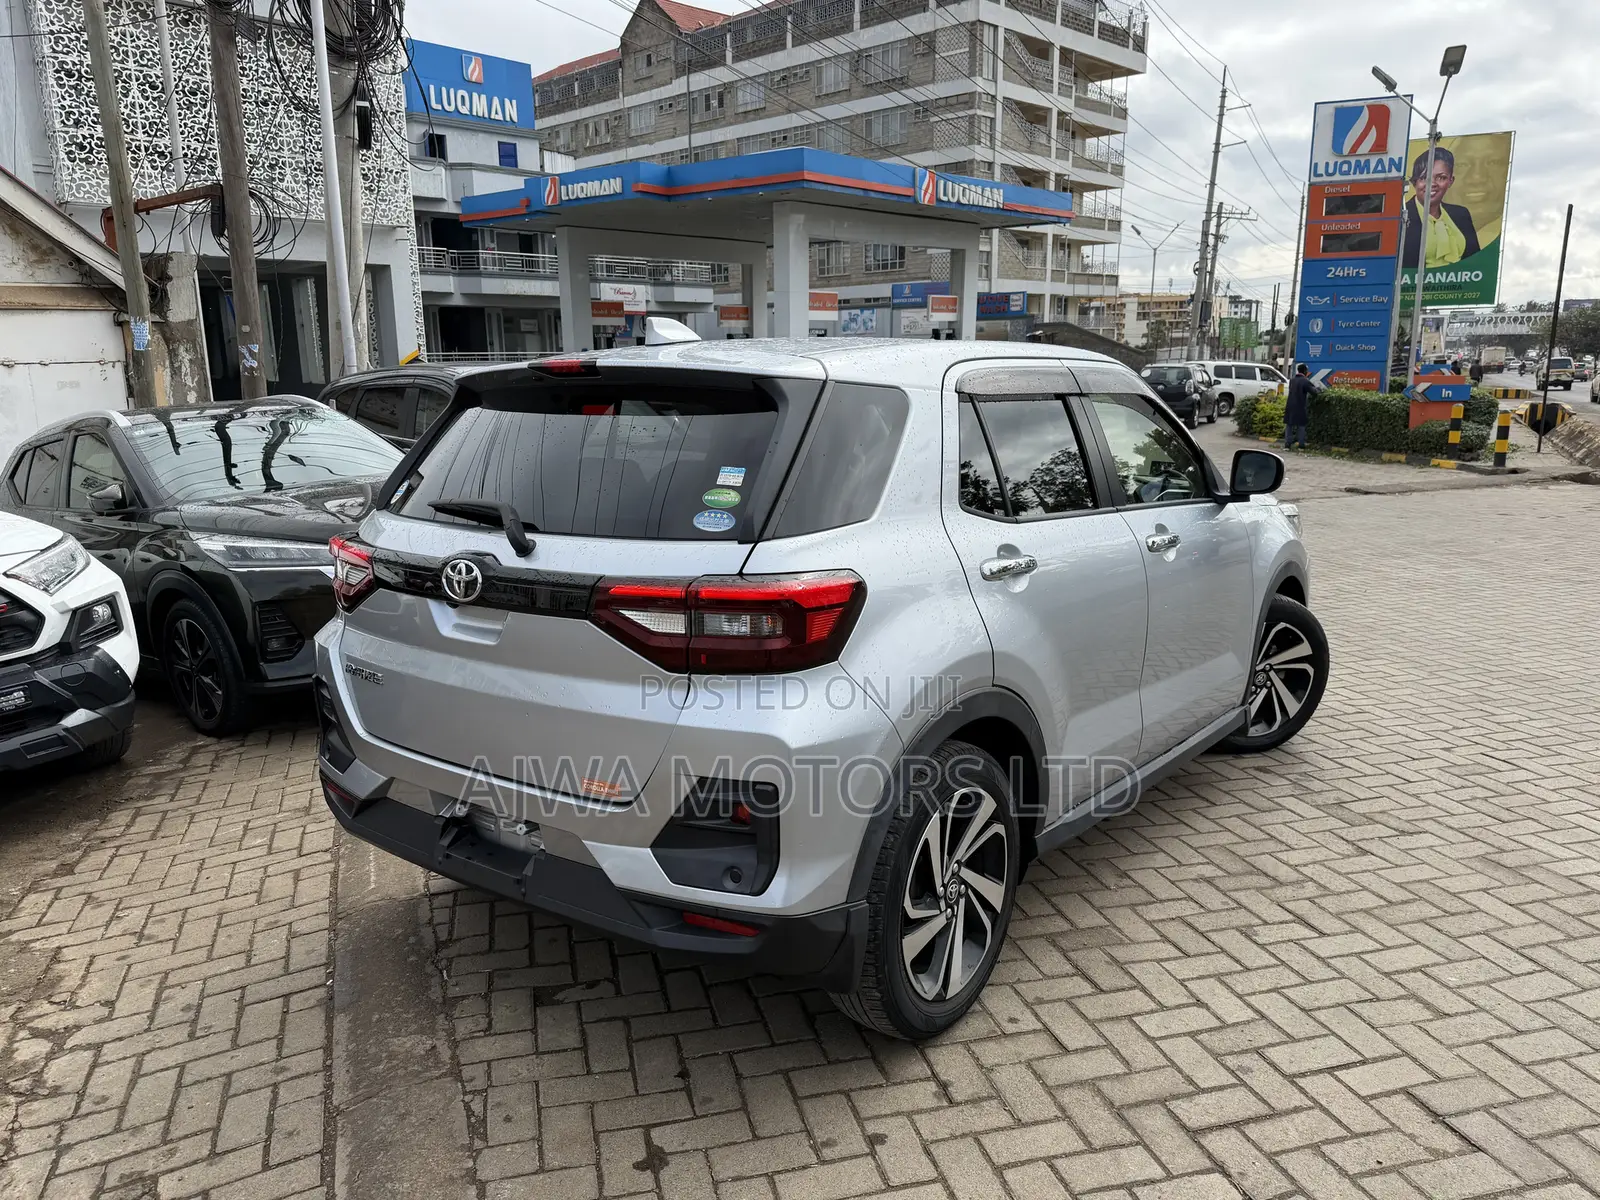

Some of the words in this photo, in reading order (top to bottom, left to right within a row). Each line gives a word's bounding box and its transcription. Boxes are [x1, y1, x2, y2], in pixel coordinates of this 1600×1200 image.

[428, 84, 518, 123] LUQMAN
[1313, 156, 1403, 178] LUQMAN
[561, 177, 622, 201] LUQMAN
[1324, 185, 1351, 194] Diesel
[937, 180, 1004, 209] LUQMAN
[1321, 222, 1361, 231] Unleaded
[1326, 266, 1367, 278] 24Hrs
[1340, 295, 1370, 303] Service
[1372, 295, 1388, 303] Bay
[1405, 293, 1433, 301] NAOBI
[1338, 320, 1354, 329] Tyre
[1357, 344, 1376, 352] Shop
[1442, 388, 1452, 398] In
